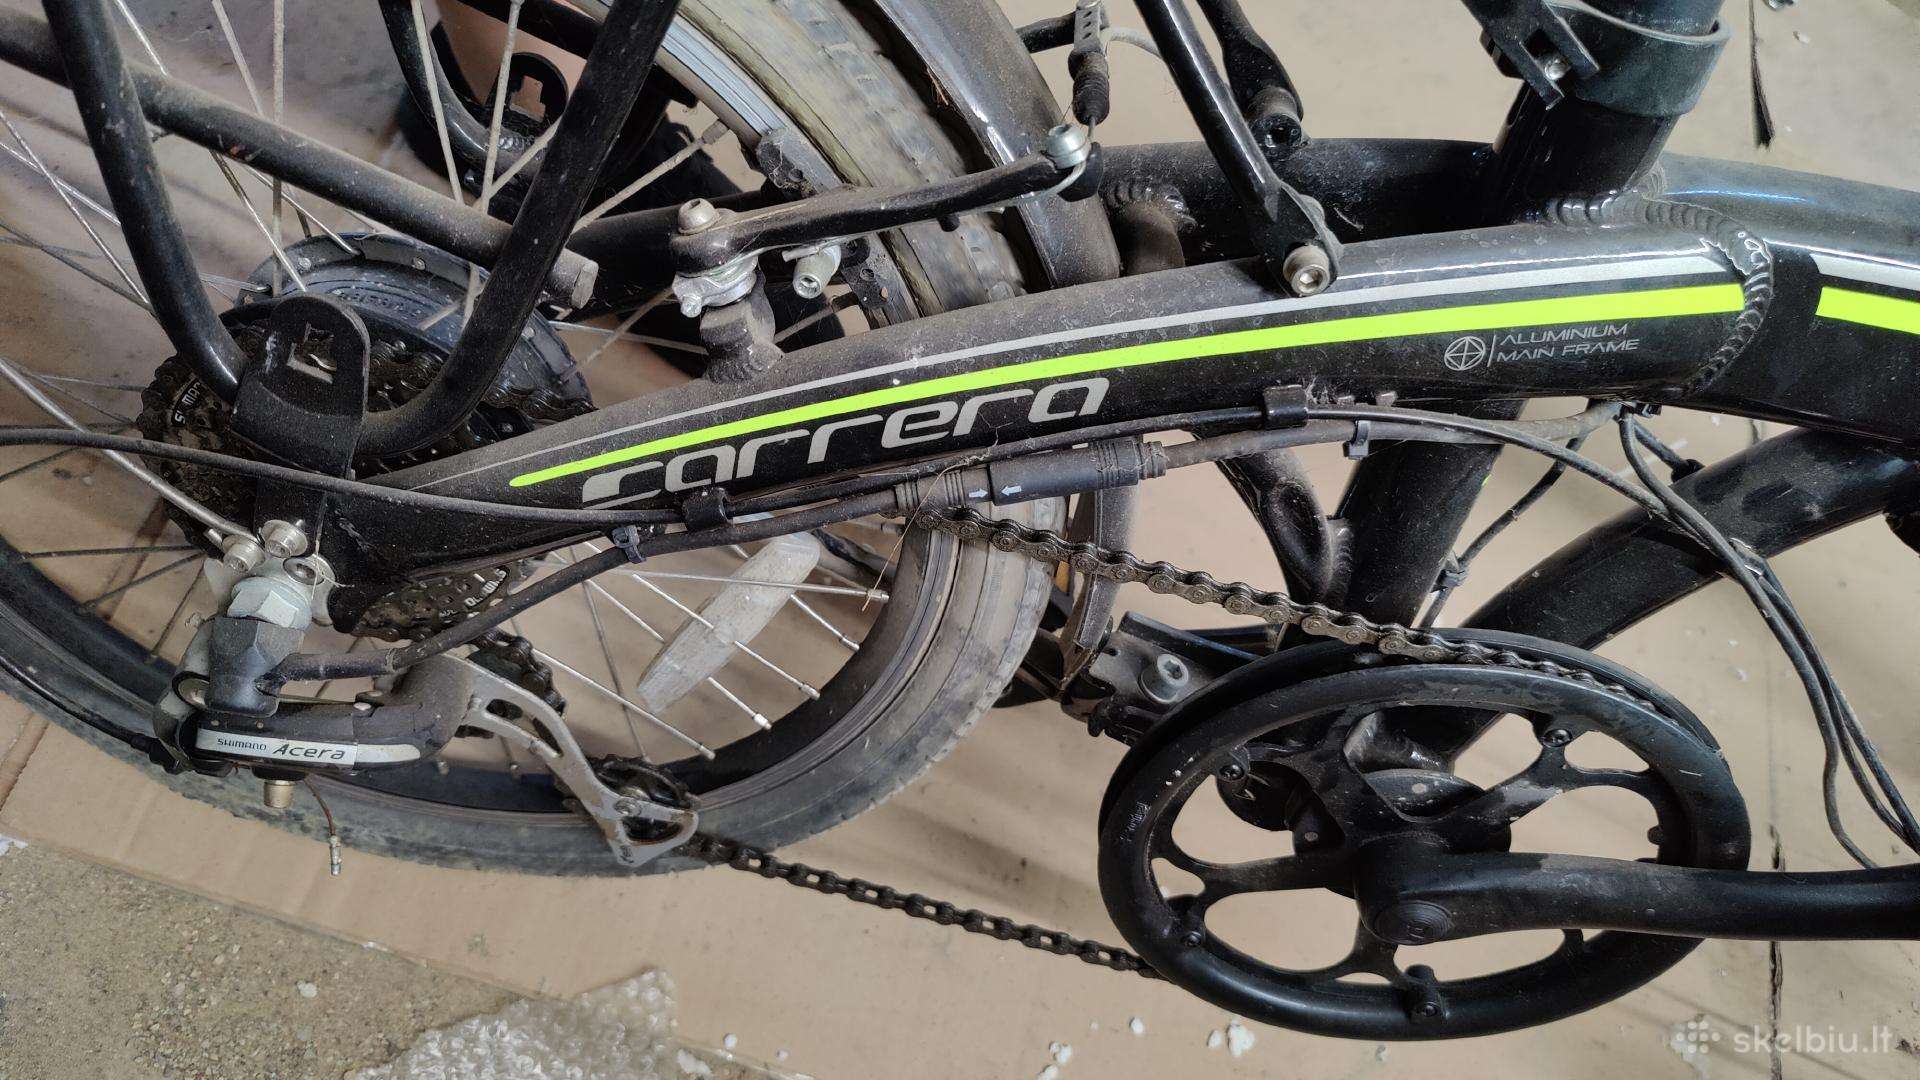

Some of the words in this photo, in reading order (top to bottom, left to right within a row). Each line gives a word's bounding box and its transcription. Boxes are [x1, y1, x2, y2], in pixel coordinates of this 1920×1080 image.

[1500, 323, 1628, 346] ALUMINIUM
[1497, 346, 1554, 362] MAIN
[1561, 338, 1640, 356] FRAME
[582, 377, 1110, 509] carrera
[217, 737, 267, 751] SHIMANO
[273, 743, 346, 761] Acera
